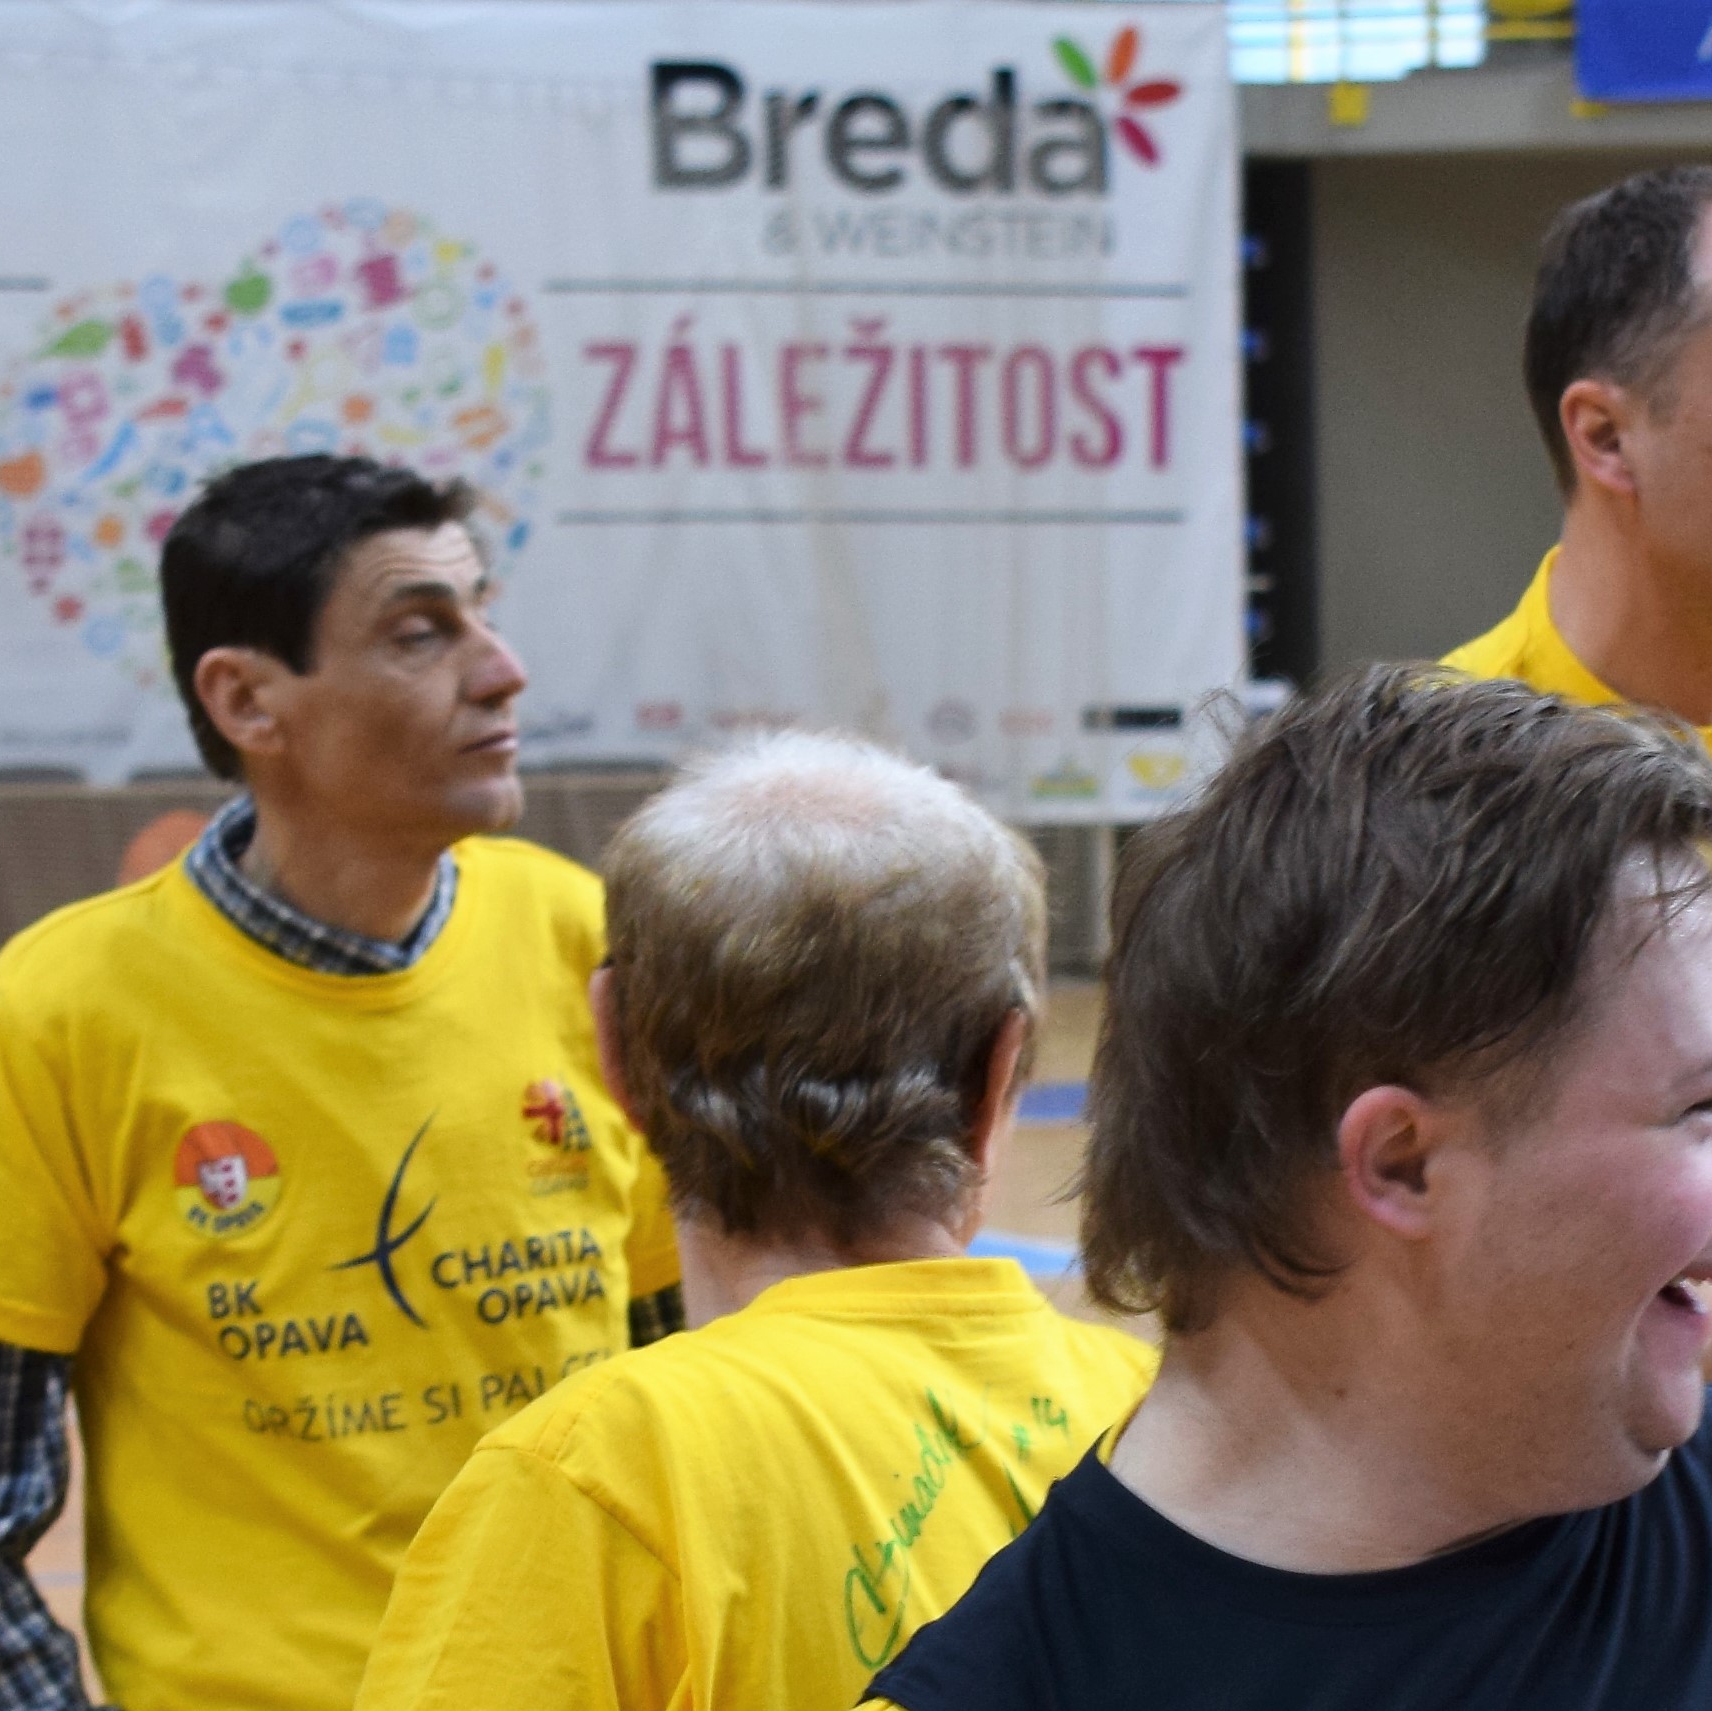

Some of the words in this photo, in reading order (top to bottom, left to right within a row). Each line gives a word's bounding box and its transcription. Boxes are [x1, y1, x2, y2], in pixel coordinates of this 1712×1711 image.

[651, 61, 1110, 196] Breda
[583, 312, 1185, 471] ZÁLEŽITOST
[432, 1229, 602, 1290] CHARITA
[208, 1281, 263, 1320] BK
[477, 1269, 606, 1324] OPAVA
[219, 1313, 370, 1361] OPAVA
[422, 1382, 462, 1425] SI
